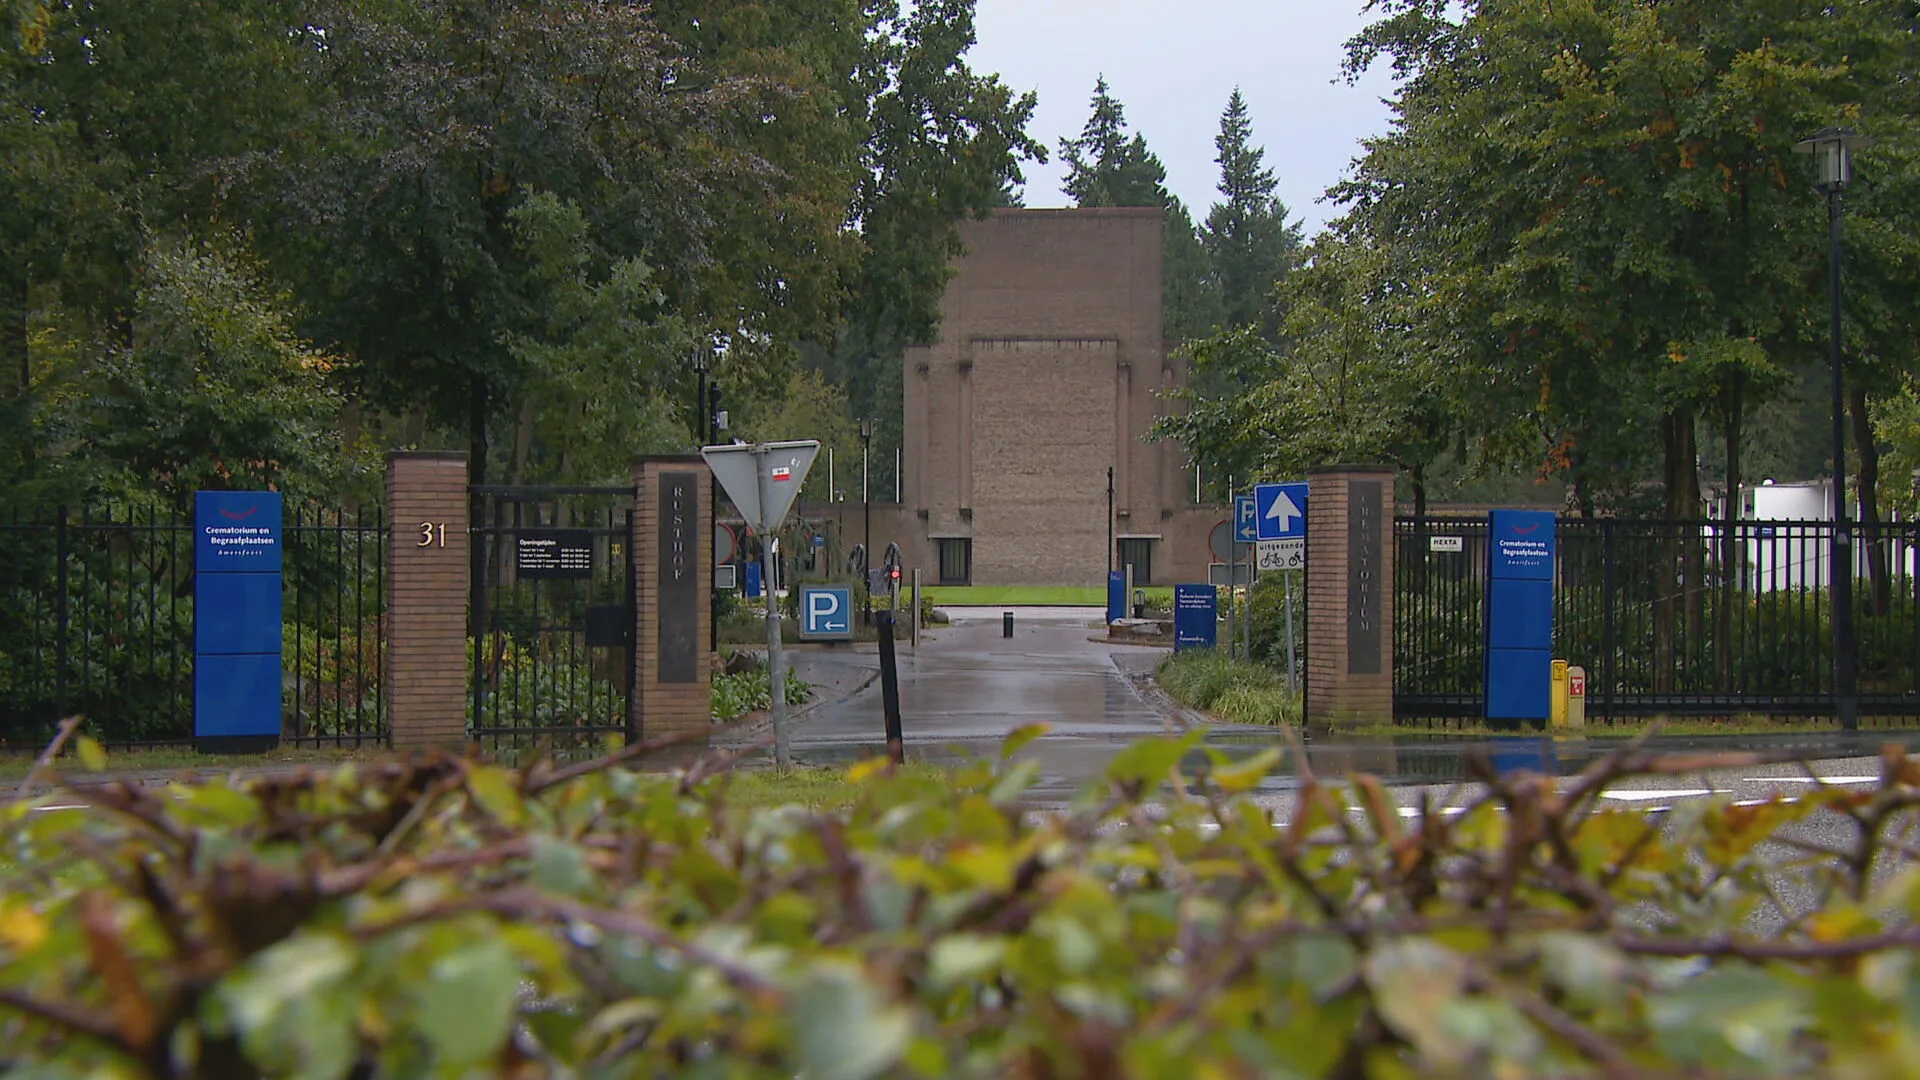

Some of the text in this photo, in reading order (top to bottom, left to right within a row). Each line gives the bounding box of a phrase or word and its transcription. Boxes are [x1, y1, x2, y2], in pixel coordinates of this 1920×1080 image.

[1241, 500, 1255, 523] P
[205, 526, 258, 534] Crematorium
[210, 536, 275, 546] Begraafplaatsen
[417, 522, 447, 548] 31
[673, 487, 683, 580] RUSTHOF
[1499, 539, 1537, 548] Crematorium
[1503, 548, 1549, 557] Begraafplaatsen
[1360, 496, 1370, 632] CREMATORIUM
[809, 592, 839, 631] P
